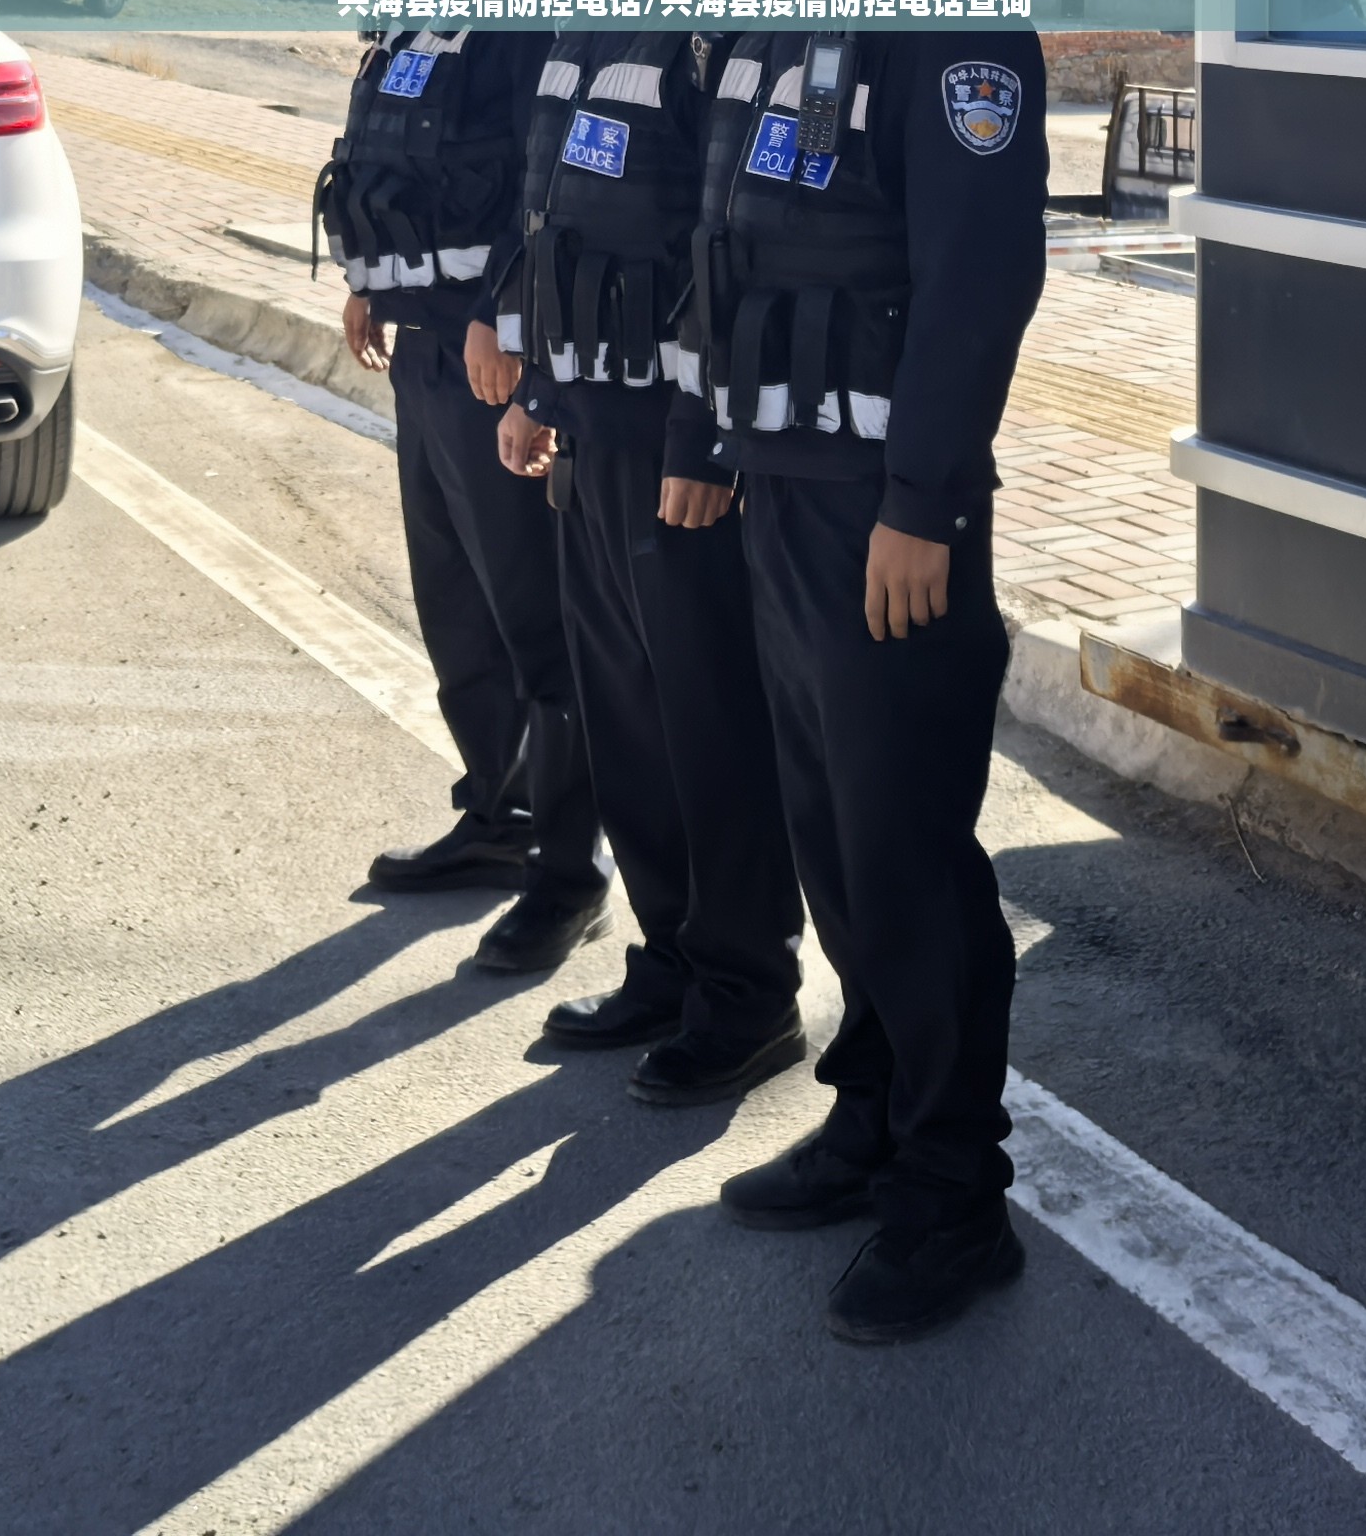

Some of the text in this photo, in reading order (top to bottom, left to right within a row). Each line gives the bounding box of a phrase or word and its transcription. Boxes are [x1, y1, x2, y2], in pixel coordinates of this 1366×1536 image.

[577, 117, 619, 150] 警察
[566, 143, 615, 170] POLICE
[756, 150, 821, 180] POLIE
